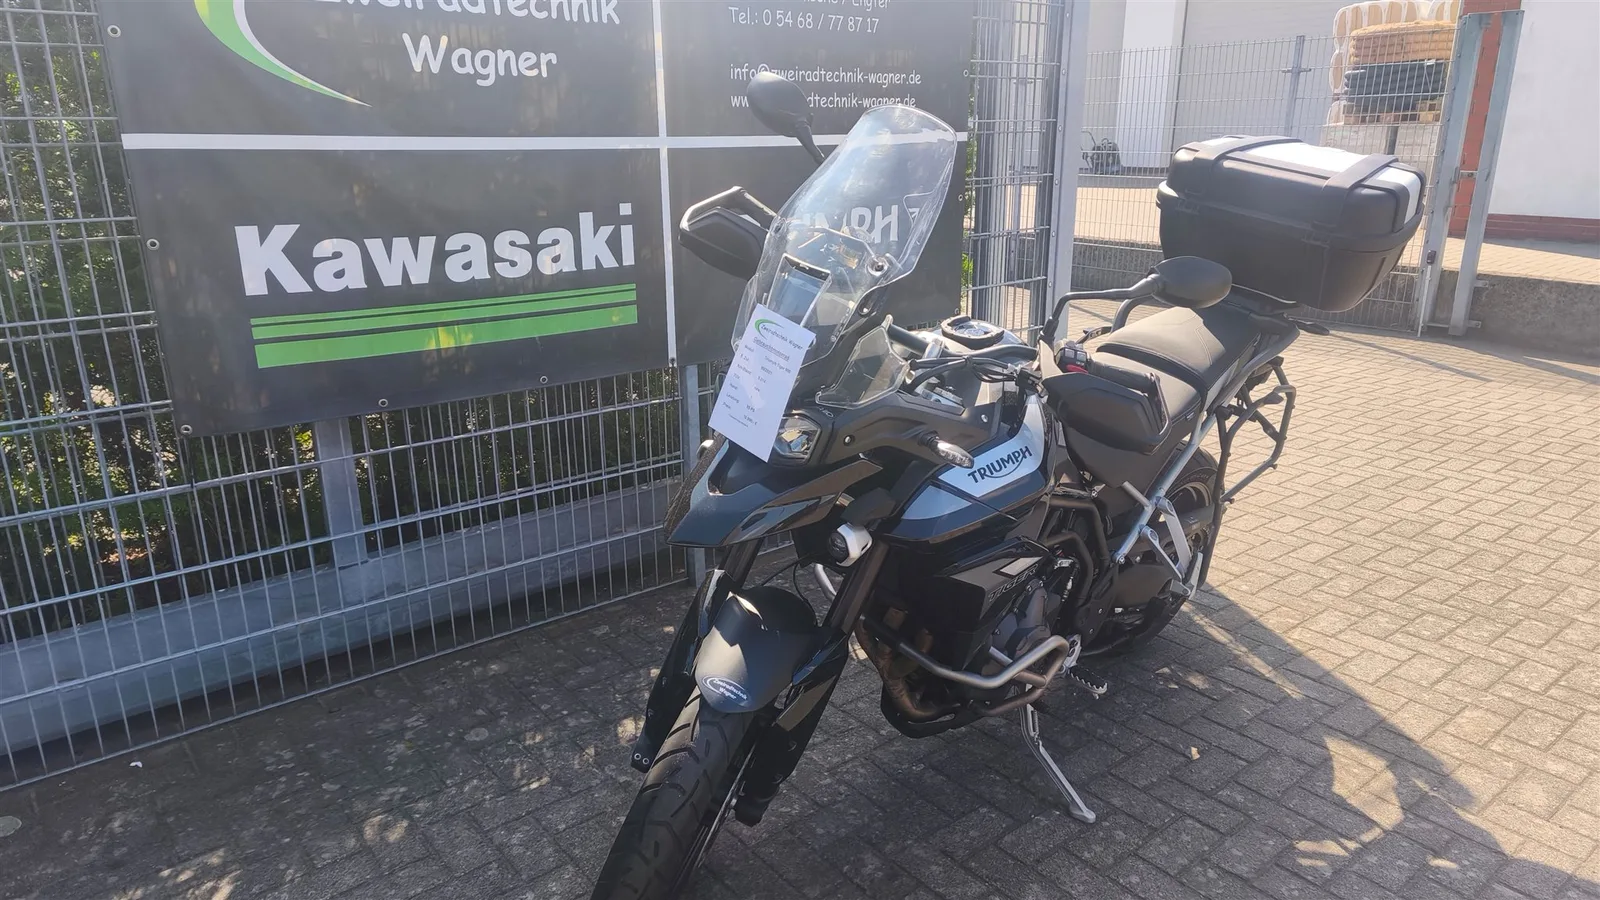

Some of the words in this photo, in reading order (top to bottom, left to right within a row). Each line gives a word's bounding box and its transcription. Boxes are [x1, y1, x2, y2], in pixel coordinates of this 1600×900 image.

[728, 7, 758, 25] Tel.:
[762, 9, 772, 26] 0
[776, 10, 793, 28] 54
[797, 12, 814, 29] 68
[817, 13, 825, 30] /
[828, 14, 844, 31] 77
[847, 16, 863, 33] 87
[866, 18, 880, 33] 17
[402, 32, 557, 87] Wagner
[234, 202, 636, 297] Kawasaki
[967, 445, 1033, 483] TRIUMPH
